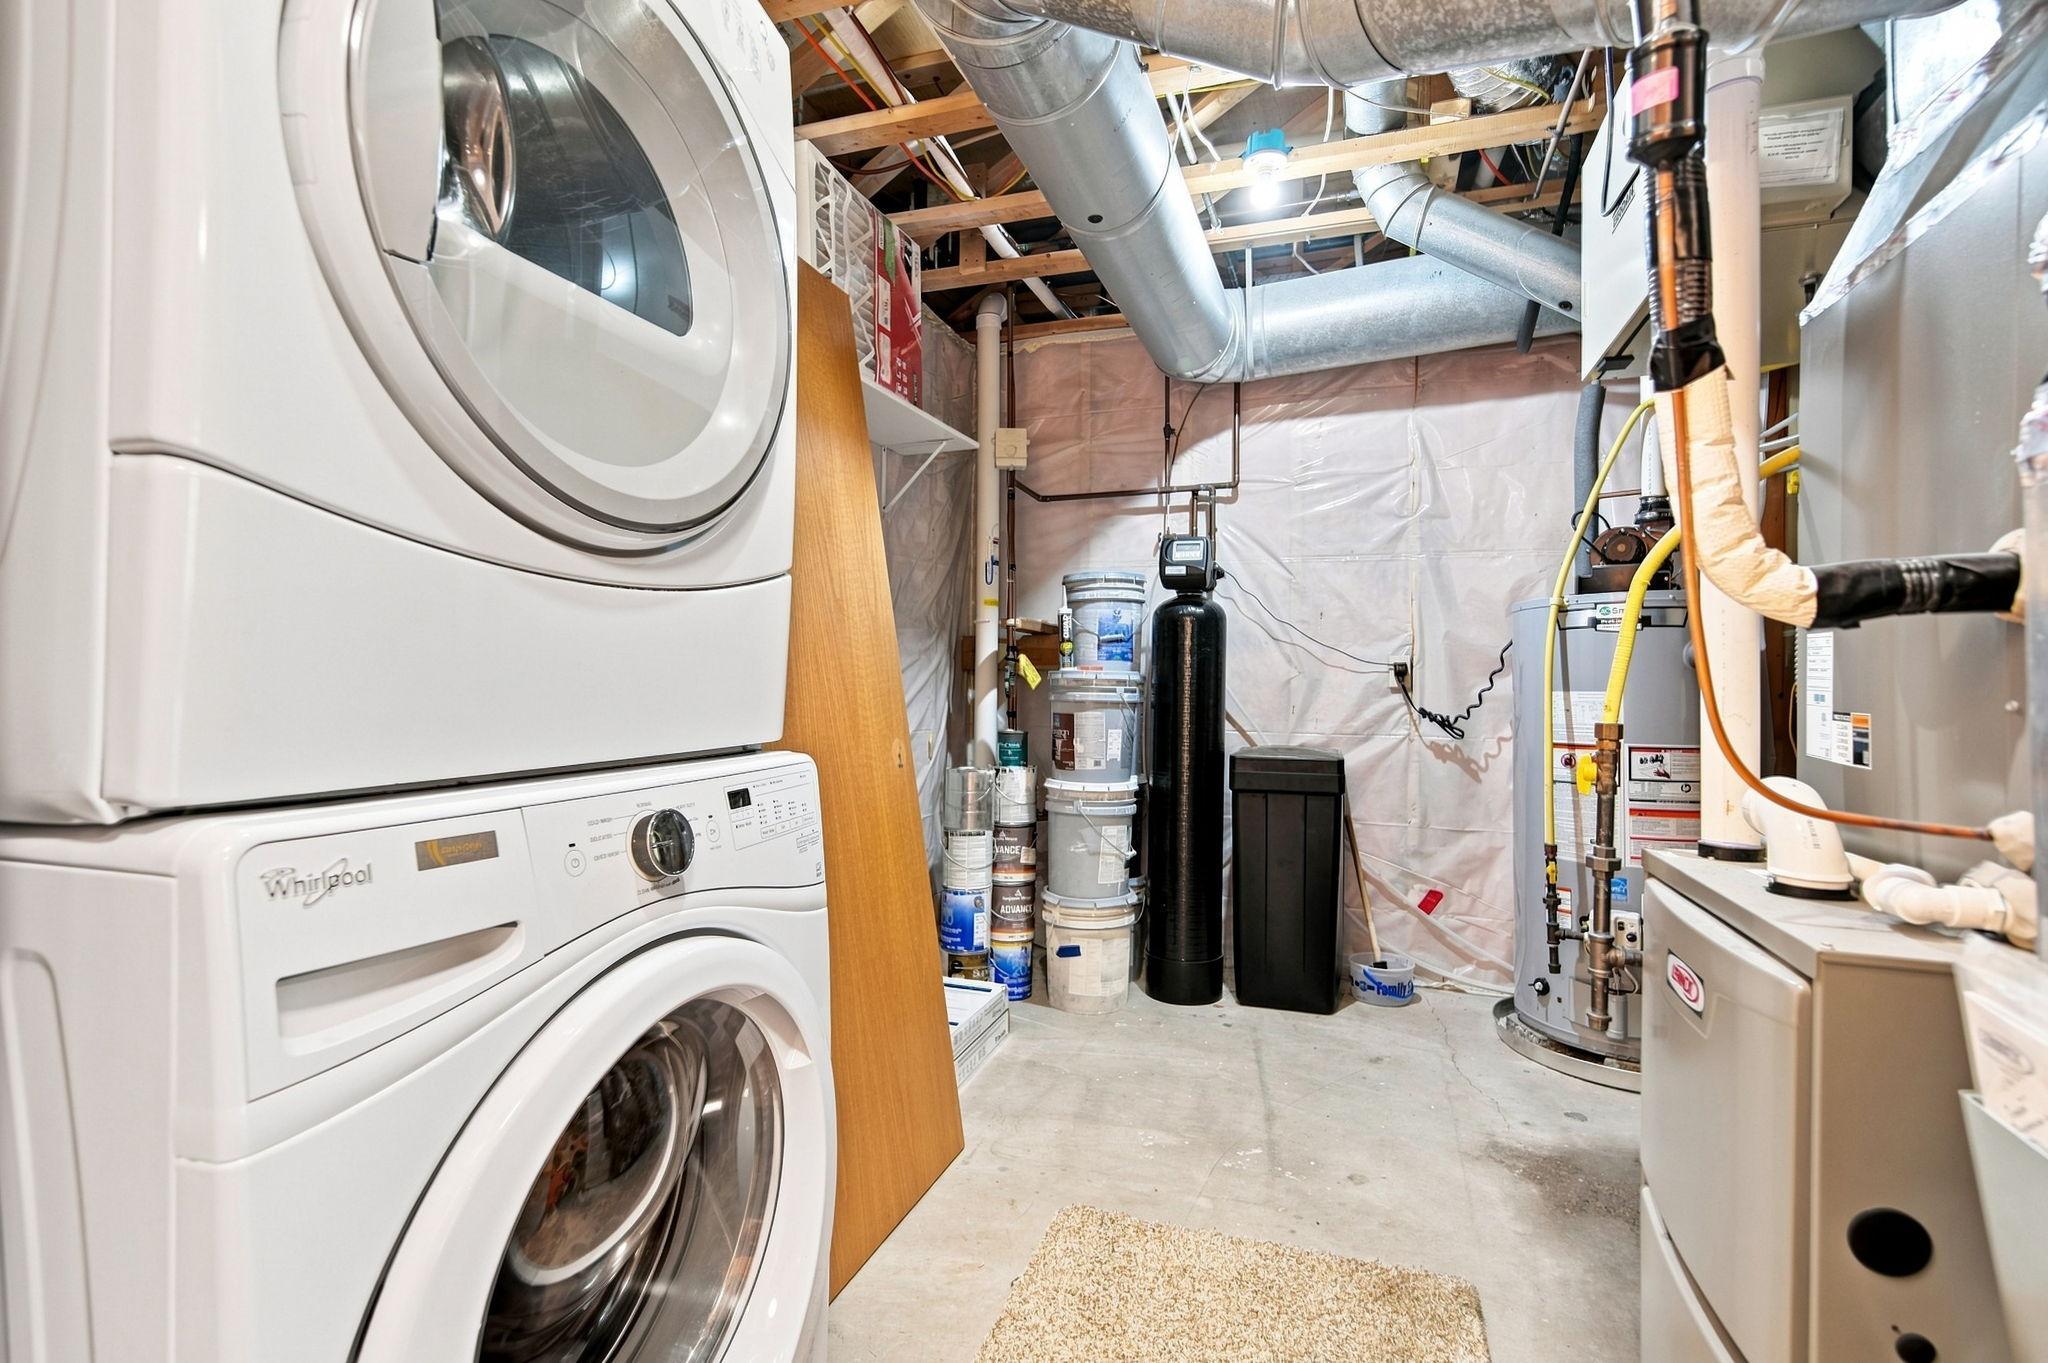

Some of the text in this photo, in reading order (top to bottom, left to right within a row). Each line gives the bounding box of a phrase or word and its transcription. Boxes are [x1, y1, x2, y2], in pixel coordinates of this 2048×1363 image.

[995, 845, 1021, 854] VANCE
[260, 858, 373, 907] Whirlpool
[1000, 904, 1033, 914] ADVANCE
